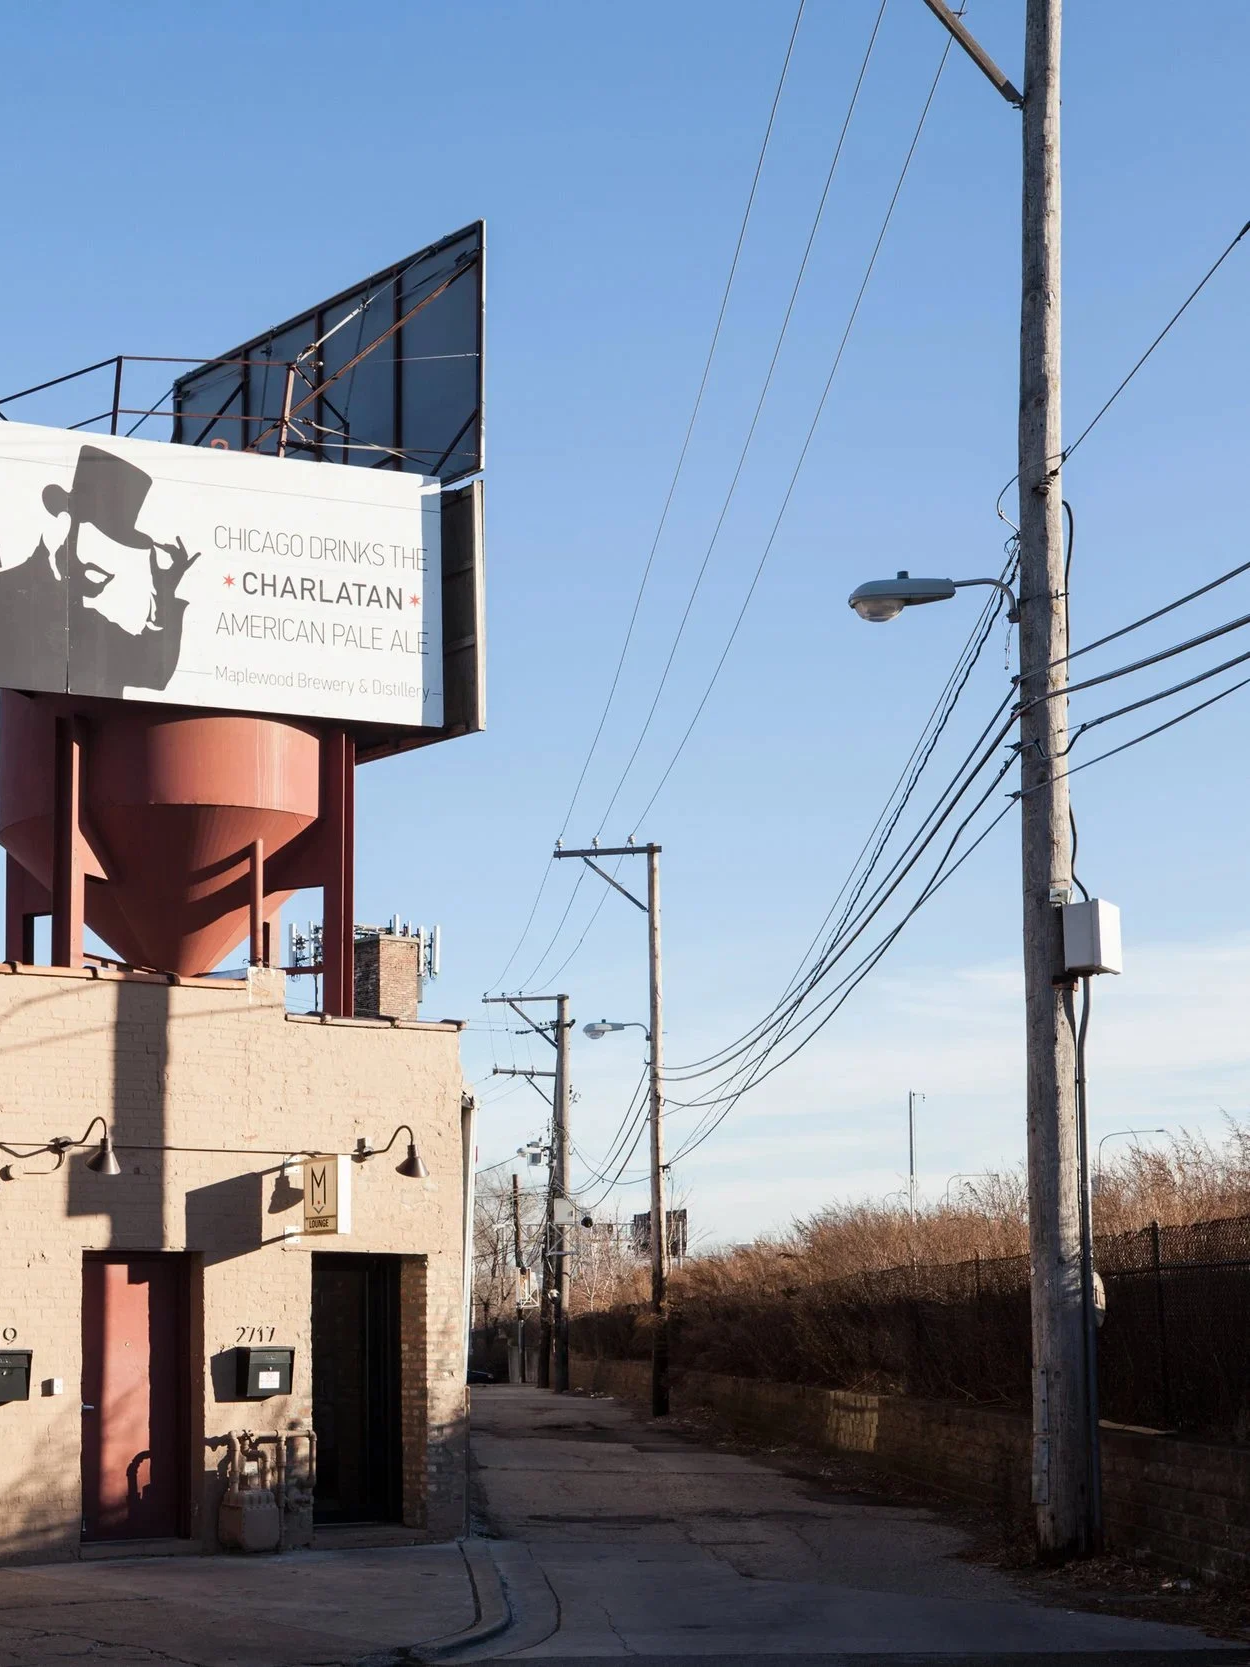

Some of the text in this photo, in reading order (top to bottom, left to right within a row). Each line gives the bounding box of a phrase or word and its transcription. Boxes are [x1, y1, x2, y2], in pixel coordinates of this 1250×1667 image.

[214, 525, 429, 572] CHICAGO DRINKS THE
[242, 571, 403, 611] CHARLATAN
[215, 612, 429, 655] AMERICAN PALE ALE
[215, 665, 430, 704] Maplewood Brewery & Distillery
[309, 1219, 329, 1229] LOUNGE
[236, 1326, 275, 1342] 2717
